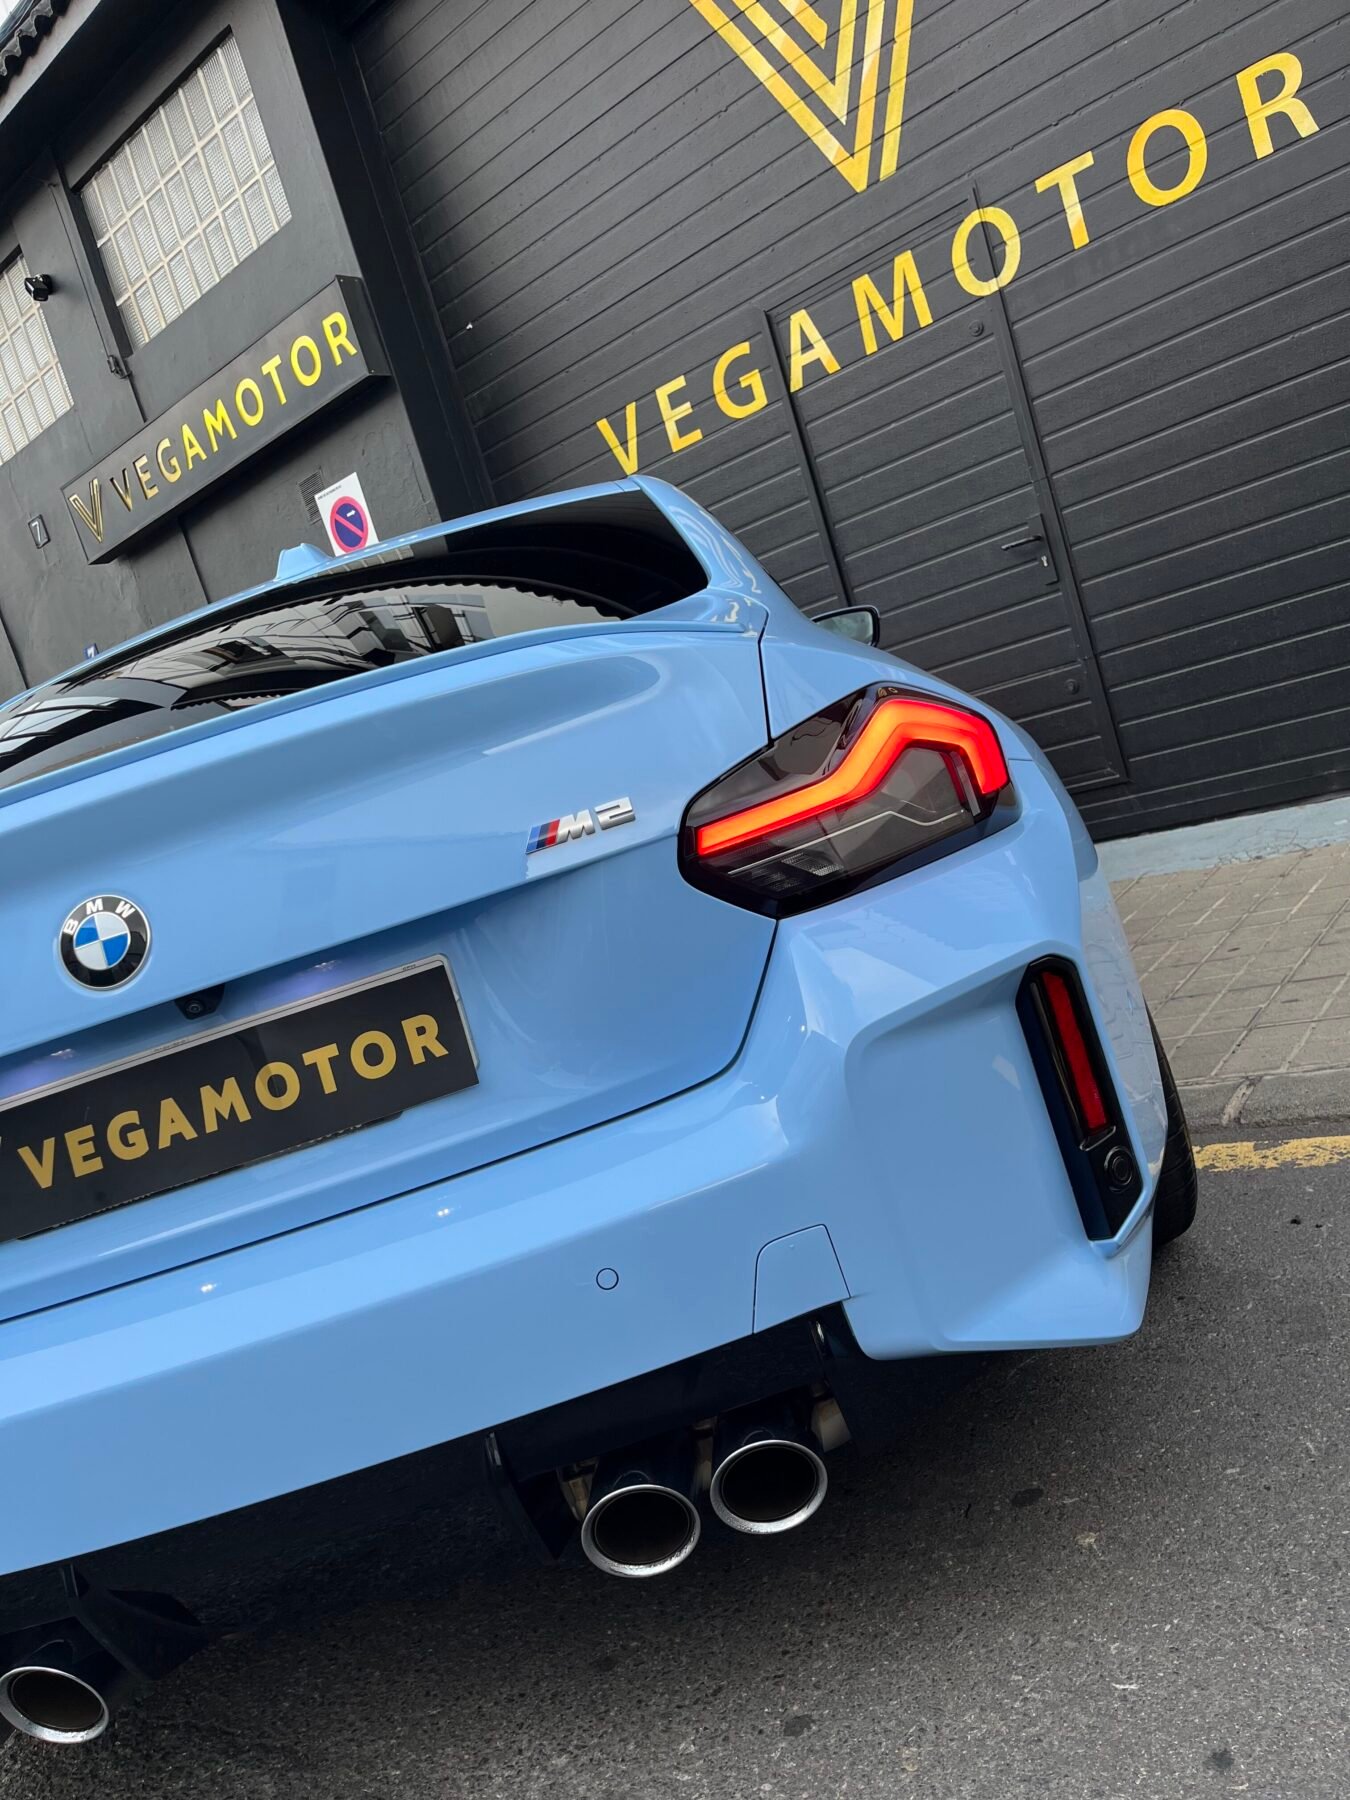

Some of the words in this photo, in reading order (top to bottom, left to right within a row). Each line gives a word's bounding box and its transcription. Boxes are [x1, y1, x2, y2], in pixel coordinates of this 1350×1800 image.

[595, 52, 1320, 475] VEGAMOTOR
[110, 311, 358, 512] VEGAMOTOR
[556, 796, 636, 843] M2
[63, 898, 136, 935] BMW
[17, 1013, 449, 1189] VEGAMOTOR
